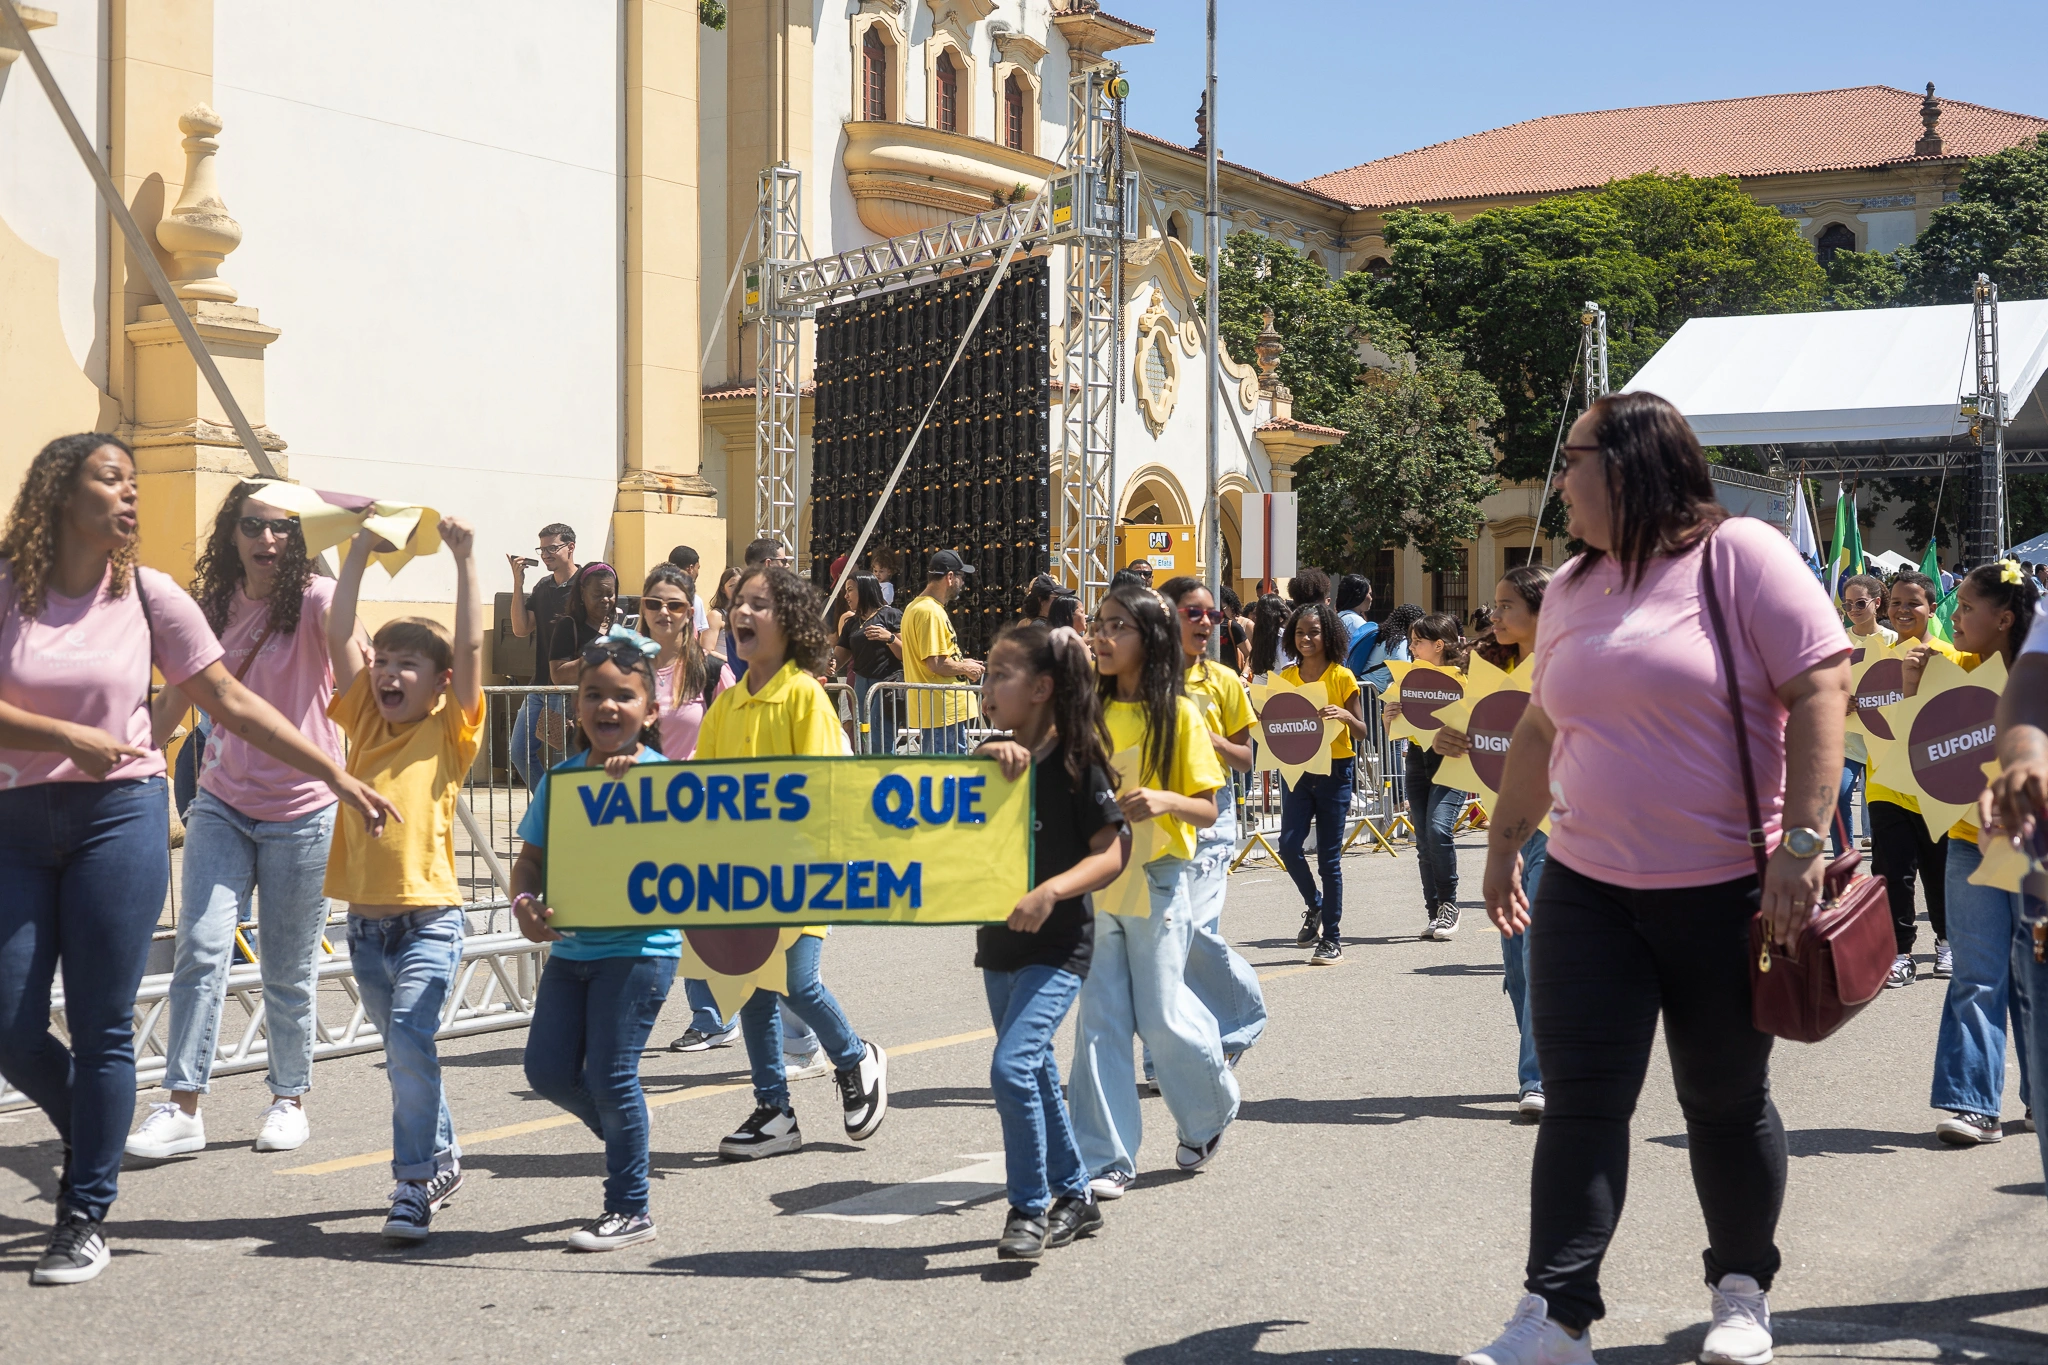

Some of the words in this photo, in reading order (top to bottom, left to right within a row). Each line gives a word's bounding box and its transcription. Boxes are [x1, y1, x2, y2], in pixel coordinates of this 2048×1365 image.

[1149, 532, 1167, 549] CAT
[1402, 689, 1461, 701] BENEVOLÊNCIA
[1268, 719, 1318, 733] GRATIDÃO
[1927, 724, 1997, 761] EUFORIA
[576, 772, 811, 827] VALORES
[872, 774, 987, 829] QUE
[627, 860, 922, 915] CONDUZEM
